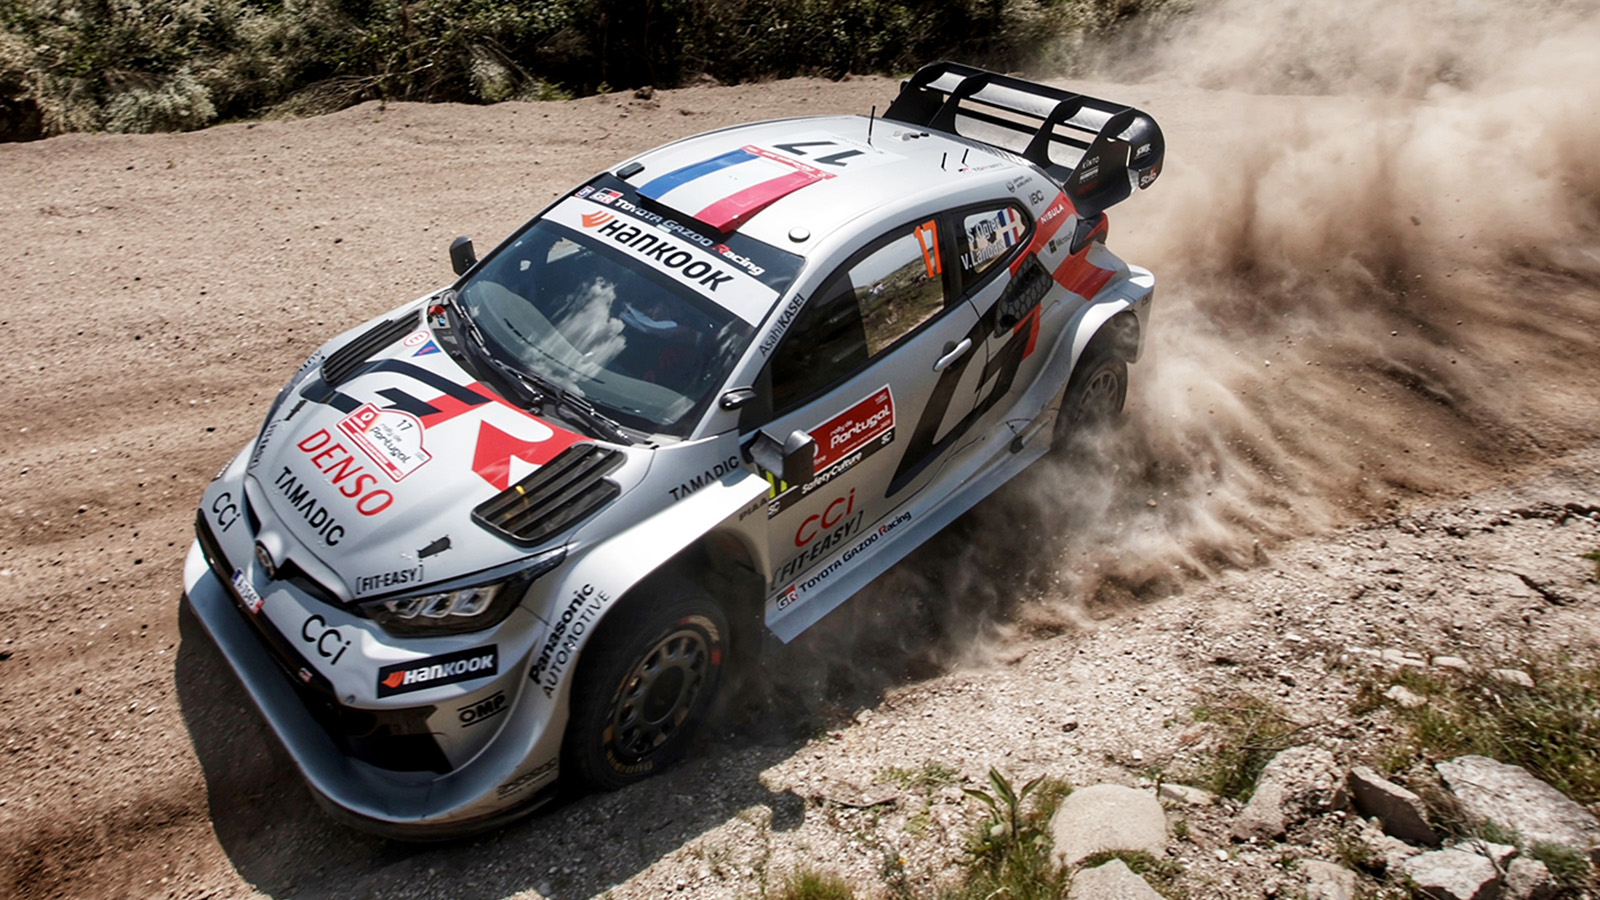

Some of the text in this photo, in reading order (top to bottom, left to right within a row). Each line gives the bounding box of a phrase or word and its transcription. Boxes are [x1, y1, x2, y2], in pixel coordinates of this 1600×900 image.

[615, 199, 663, 223] TOYOTA
[662, 219, 712, 248] GAZOO
[712, 243, 765, 277] Racing
[913, 219, 942, 278] 17
[759, 293, 805, 357] AsahiKASEI
[370, 426, 412, 464] Portugal
[396, 419, 413, 431] 17
[830, 404, 891, 449] Portugal
[297, 428, 395, 516] DENSO
[669, 456, 740, 501] TAMADIC
[802, 452, 862, 495] SafetyCulture
[274, 466, 346, 547] TAMADIC
[798, 560, 842, 593] TOYOTA
[841, 534, 879, 563] GAZOO
[877, 510, 912, 538] Racing
[528, 583, 594, 685] Panasonic
[541, 589, 612, 699] AUTOMOTIVE
[459, 695, 506, 724] OMP
